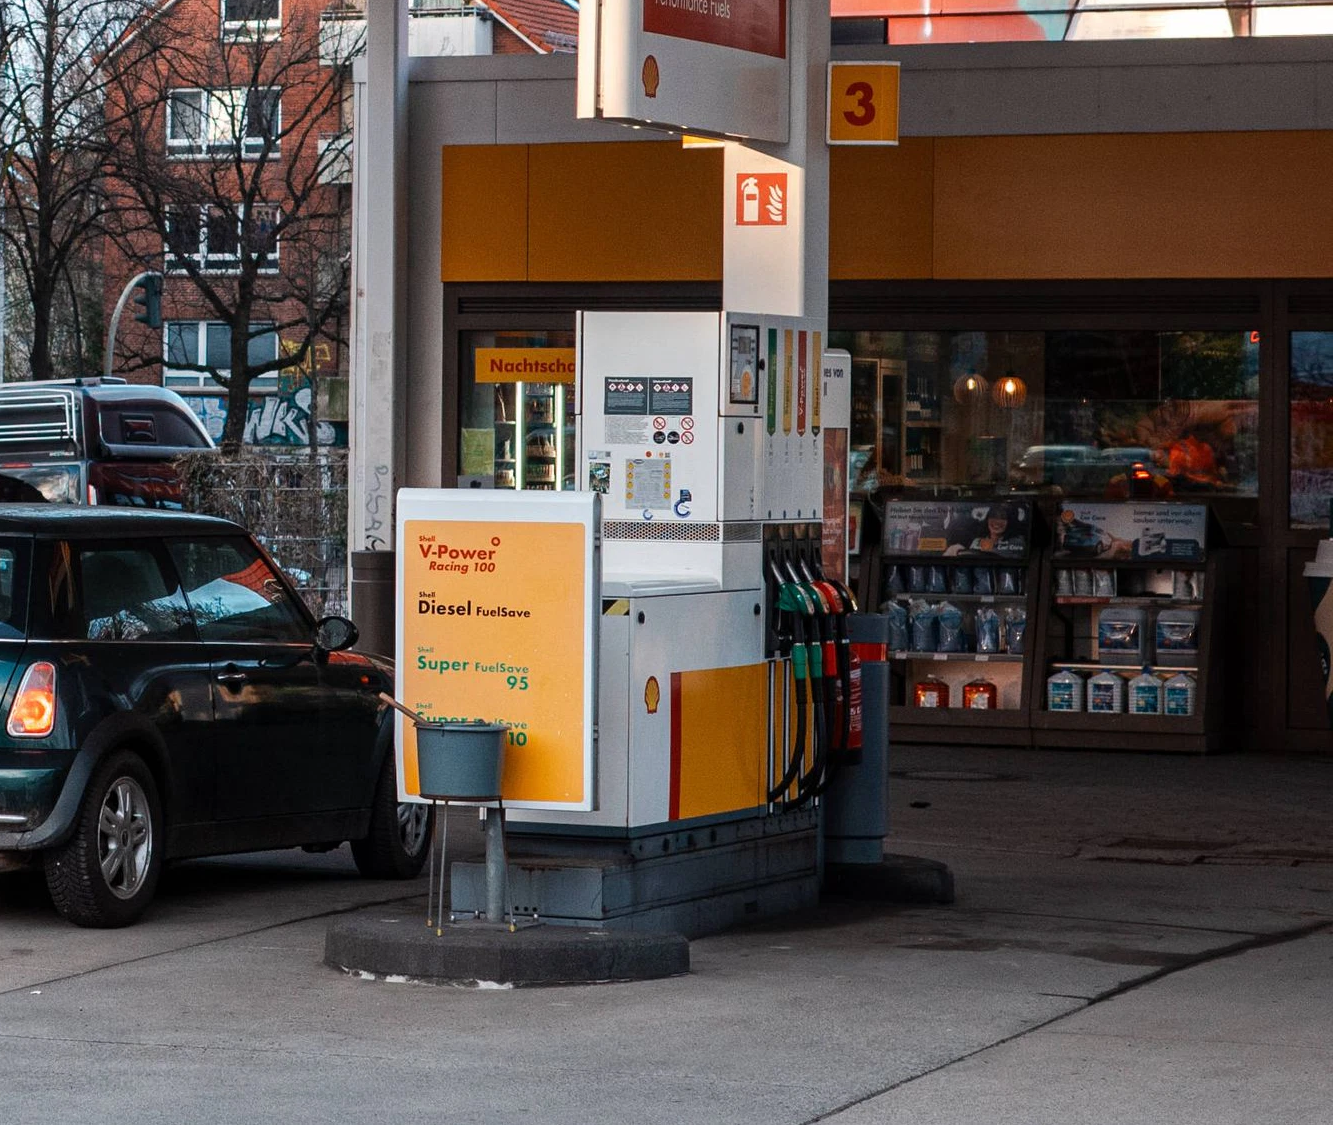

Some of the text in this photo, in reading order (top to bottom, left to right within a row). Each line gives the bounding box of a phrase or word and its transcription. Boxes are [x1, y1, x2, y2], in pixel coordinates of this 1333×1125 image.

[843, 81, 876, 127] 3
[419, 544, 496, 560] V-Power
[429, 561, 496, 575] Racing 100
[418, 599, 531, 618] Diesel FuelSave
[417, 655, 529, 674] Super FuelSave
[506, 675, 529, 691] 95
